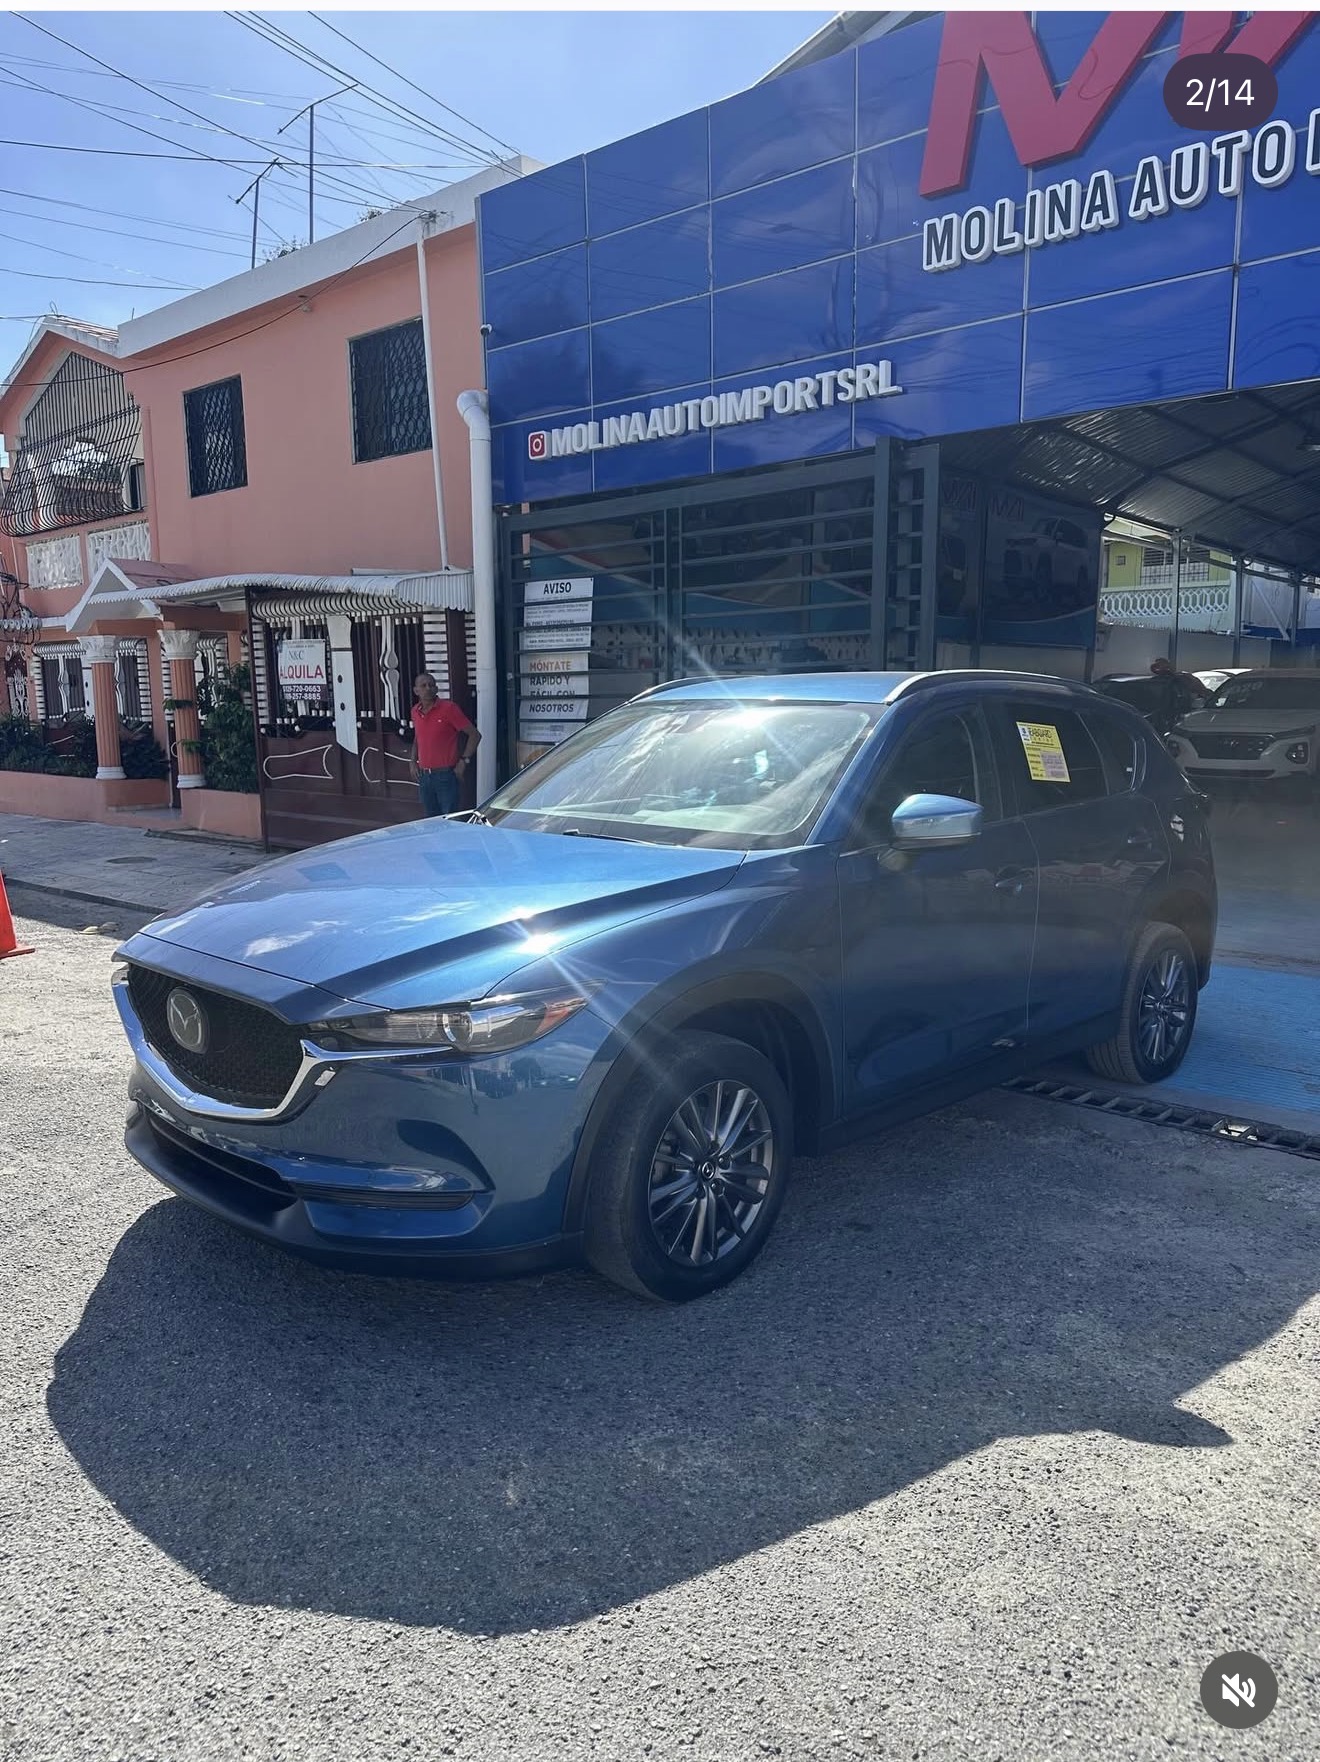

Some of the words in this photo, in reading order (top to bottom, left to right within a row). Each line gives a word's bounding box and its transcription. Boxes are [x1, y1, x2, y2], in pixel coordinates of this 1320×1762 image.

[922, 169, 1119, 273] MOLINA
[1128, 120, 1296, 221] AUTO
[551, 360, 903, 457] MOLINAAUTOIMPORTSRL
[543, 581, 572, 595] AVISO
[529, 659, 572, 671] MÓNTATE
[528, 703, 575, 713] NOSOTROS
